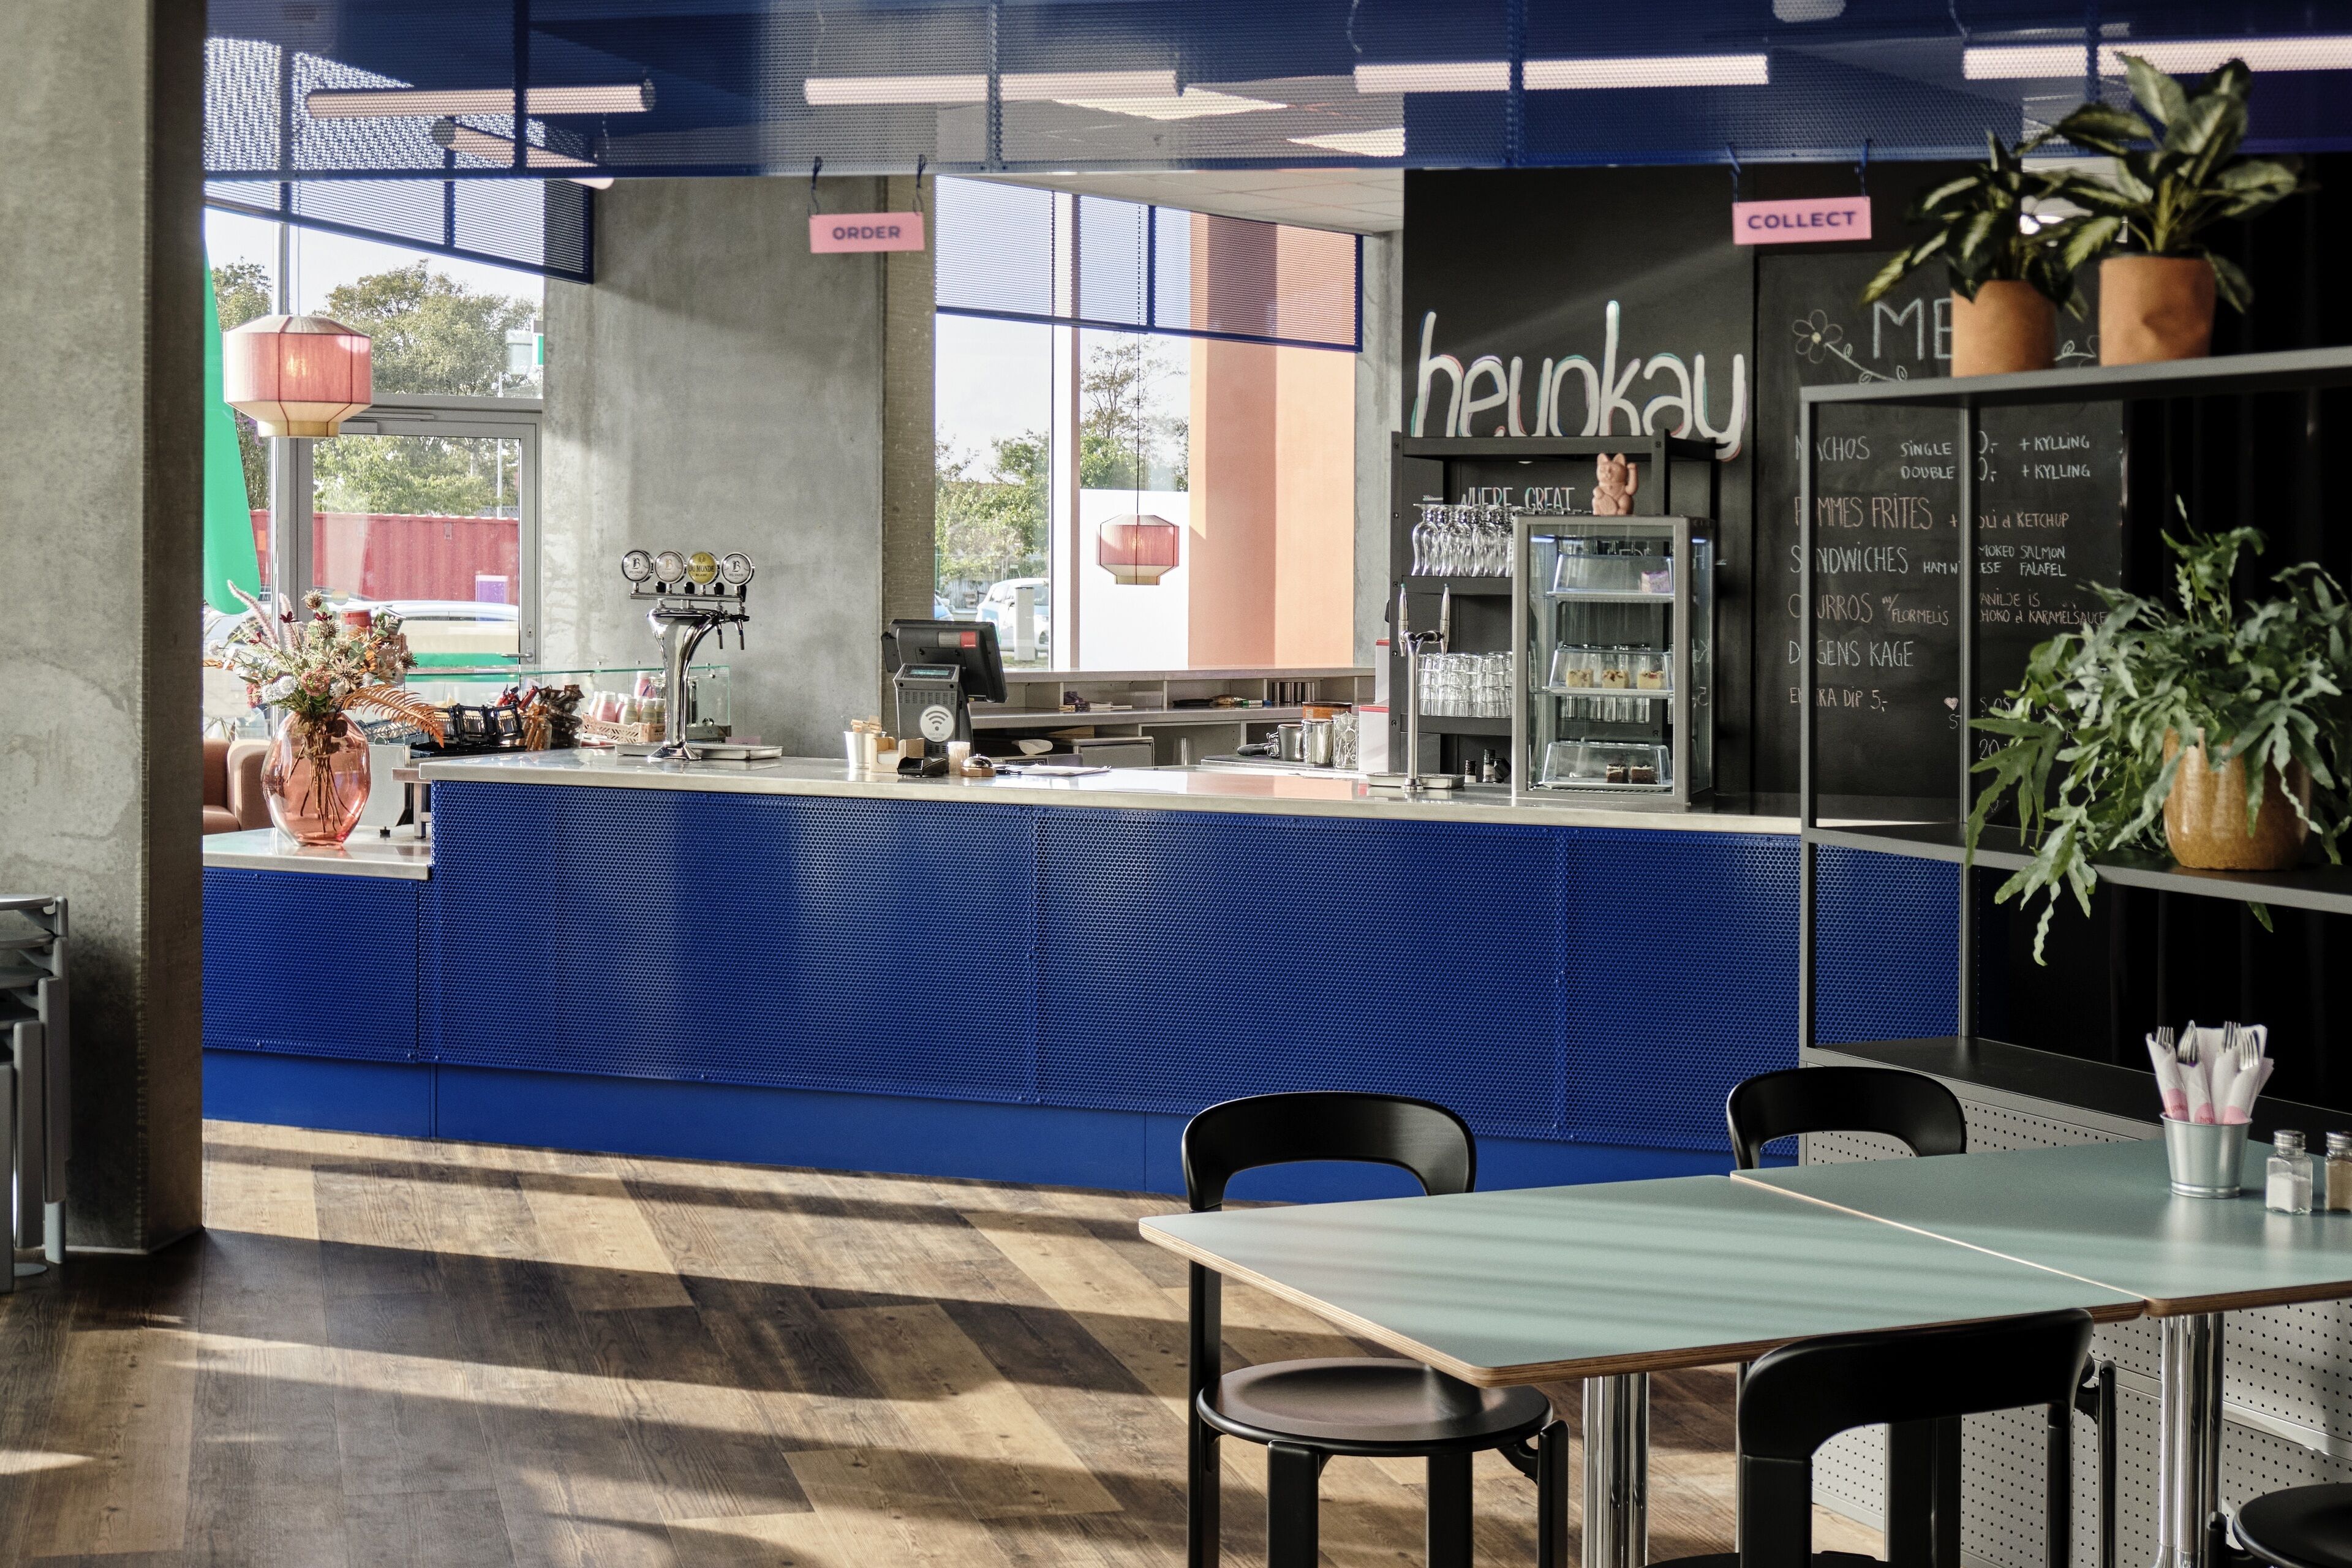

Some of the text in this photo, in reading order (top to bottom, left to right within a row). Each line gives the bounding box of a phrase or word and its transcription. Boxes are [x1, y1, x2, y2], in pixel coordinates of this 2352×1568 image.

[1748, 211, 1856, 229] COLLECT
[832, 226, 900, 240] ORDER
[1901, 466, 1956, 480] DOUBLE
[2035, 464, 2090, 480] KYLLING
[1525, 487, 1575, 510] GREAT
[2017, 511, 2070, 528] KETCHUP
[1790, 541, 1909, 574] SNDWICHES
[1923, 562, 1947, 575] HAM
[2020, 562, 2067, 577] FALAFEL
[1979, 545, 2066, 560] MOKED SALMON
[1788, 593, 1873, 624] CURROS
[1979, 609, 2011, 623] HOKO
[1789, 640, 1914, 666] DGENS KAGE
